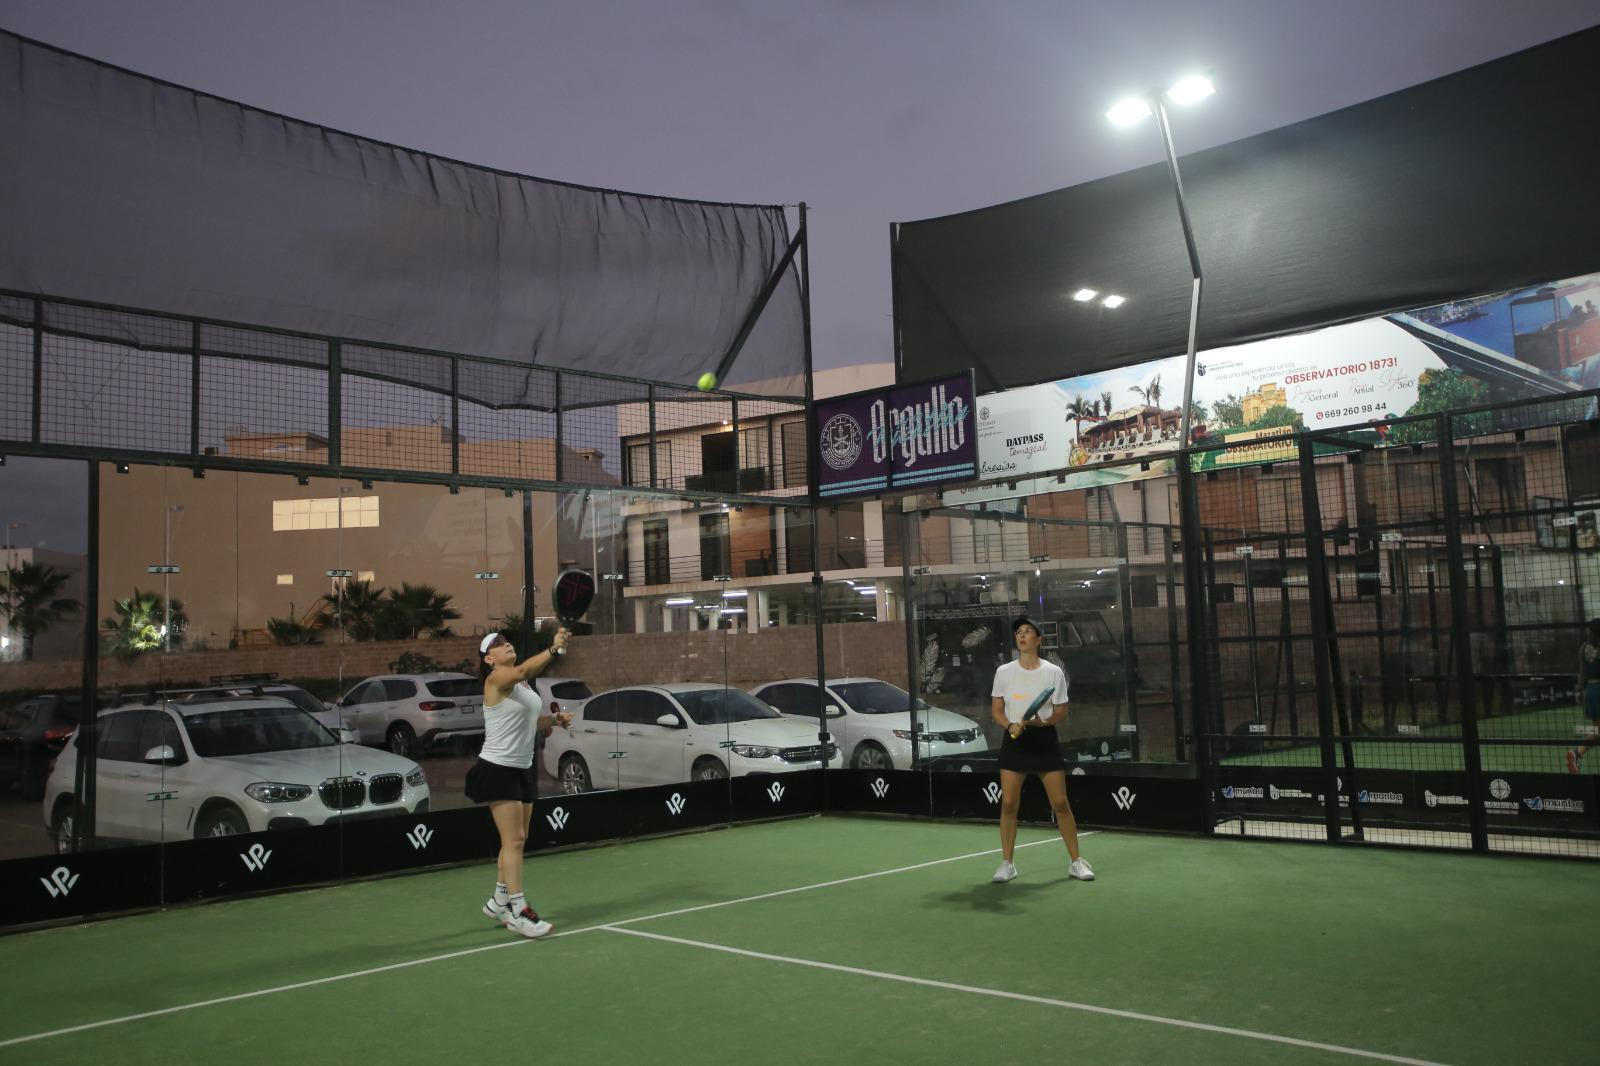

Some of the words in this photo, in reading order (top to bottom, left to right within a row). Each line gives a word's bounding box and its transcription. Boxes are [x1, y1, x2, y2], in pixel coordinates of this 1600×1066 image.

[1285, 363, 1367, 385] OBSERVATORIO
[1369, 357, 1398, 370] 1873!
[1309, 391, 1339, 402] General
[1324, 408, 1341, 419] 669
[1343, 406, 1359, 416] 260
[1361, 404, 1373, 414] 98
[1375, 402, 1387, 411] 44
[1006, 433, 1044, 447] DAYPASS
